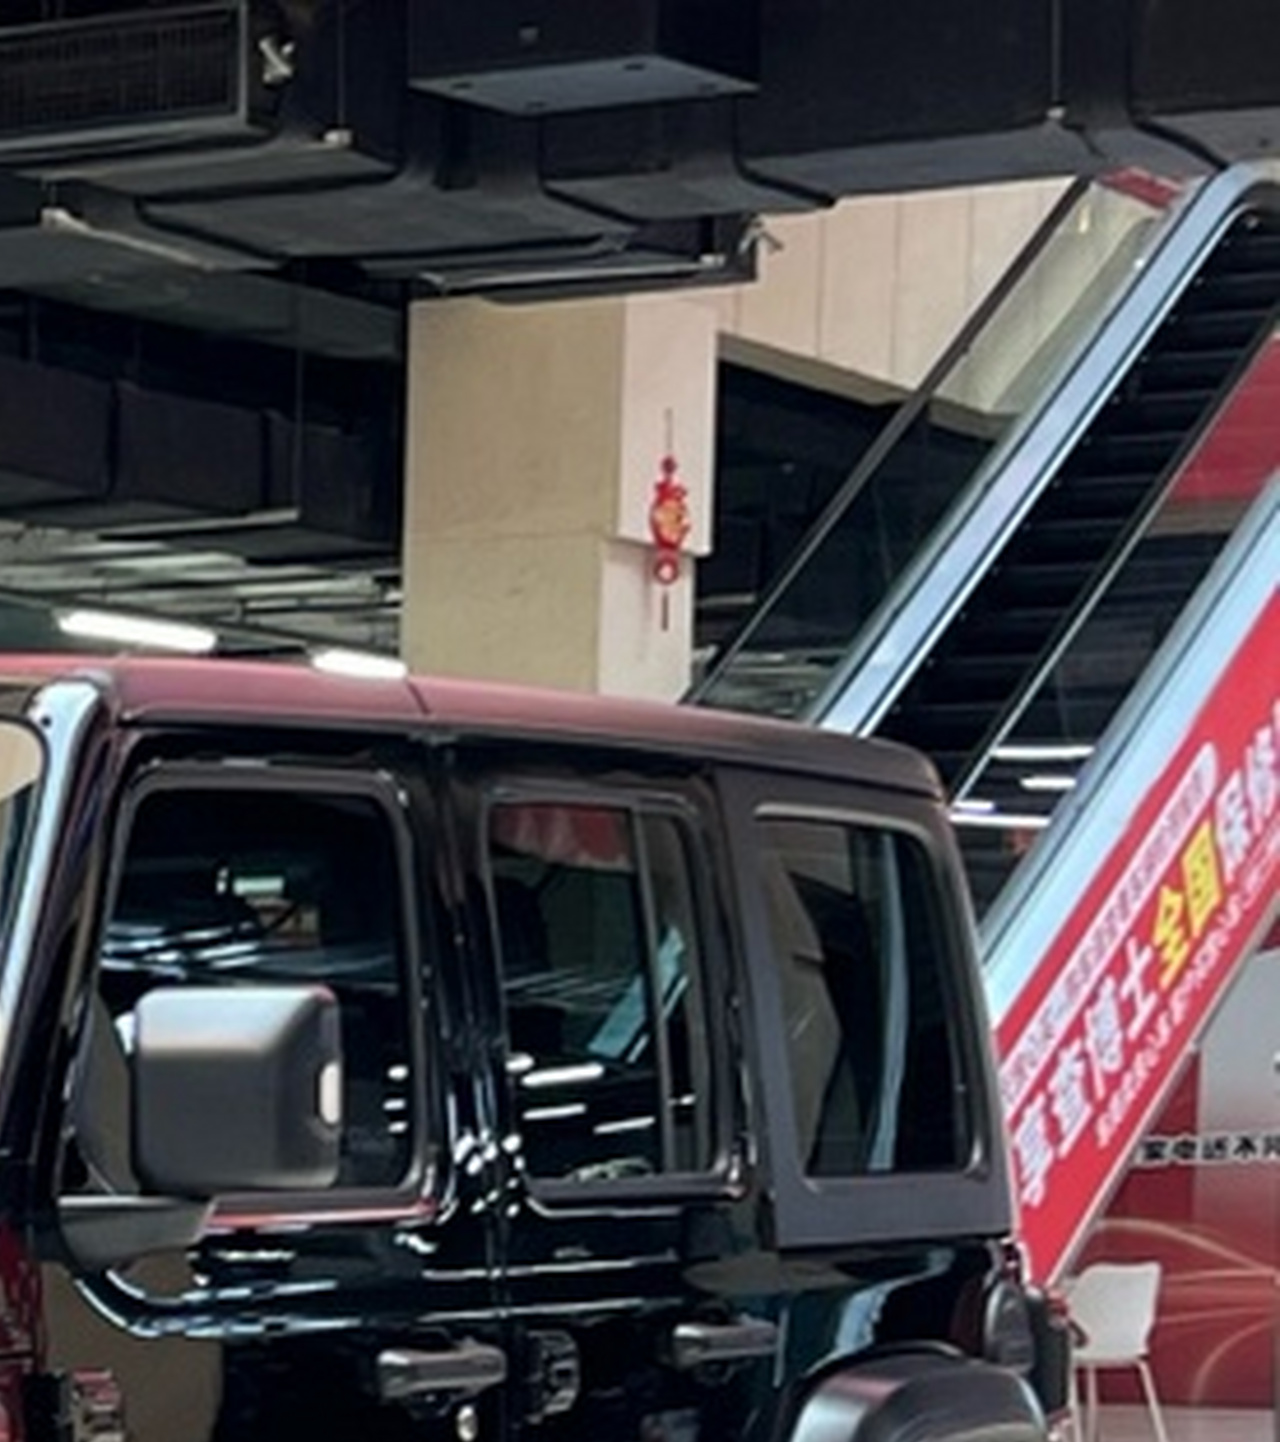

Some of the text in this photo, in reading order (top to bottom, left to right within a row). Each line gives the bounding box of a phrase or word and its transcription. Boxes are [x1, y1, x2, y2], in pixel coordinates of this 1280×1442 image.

[1014, 700, 1280, 1207] 享查博士全国保修
